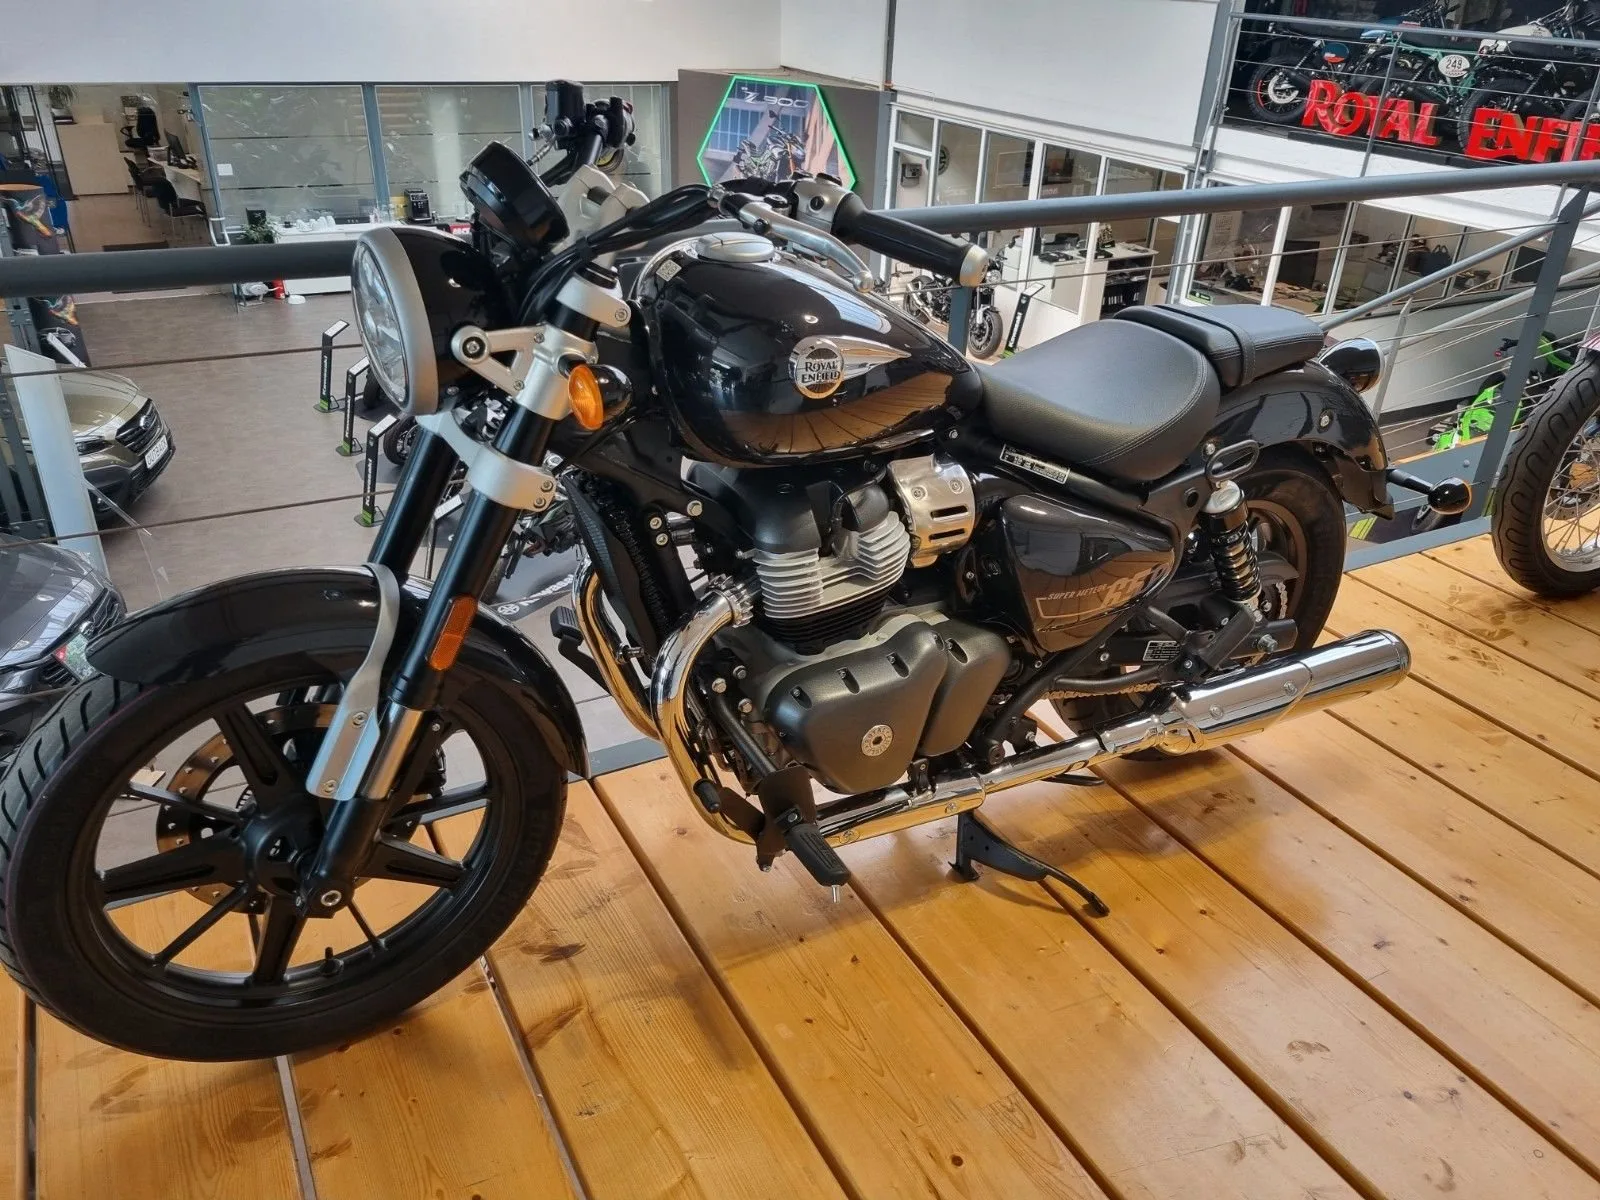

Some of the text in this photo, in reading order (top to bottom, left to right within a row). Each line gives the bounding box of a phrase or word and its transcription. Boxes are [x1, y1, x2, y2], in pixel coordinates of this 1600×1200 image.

[1446, 60, 1462, 69] 249
[1302, 80, 1438, 145] ROYAL
[804, 361, 838, 372] ROYAL
[801, 371, 840, 383] ENFIELD
[1048, 591, 1075, 600] SUPER
